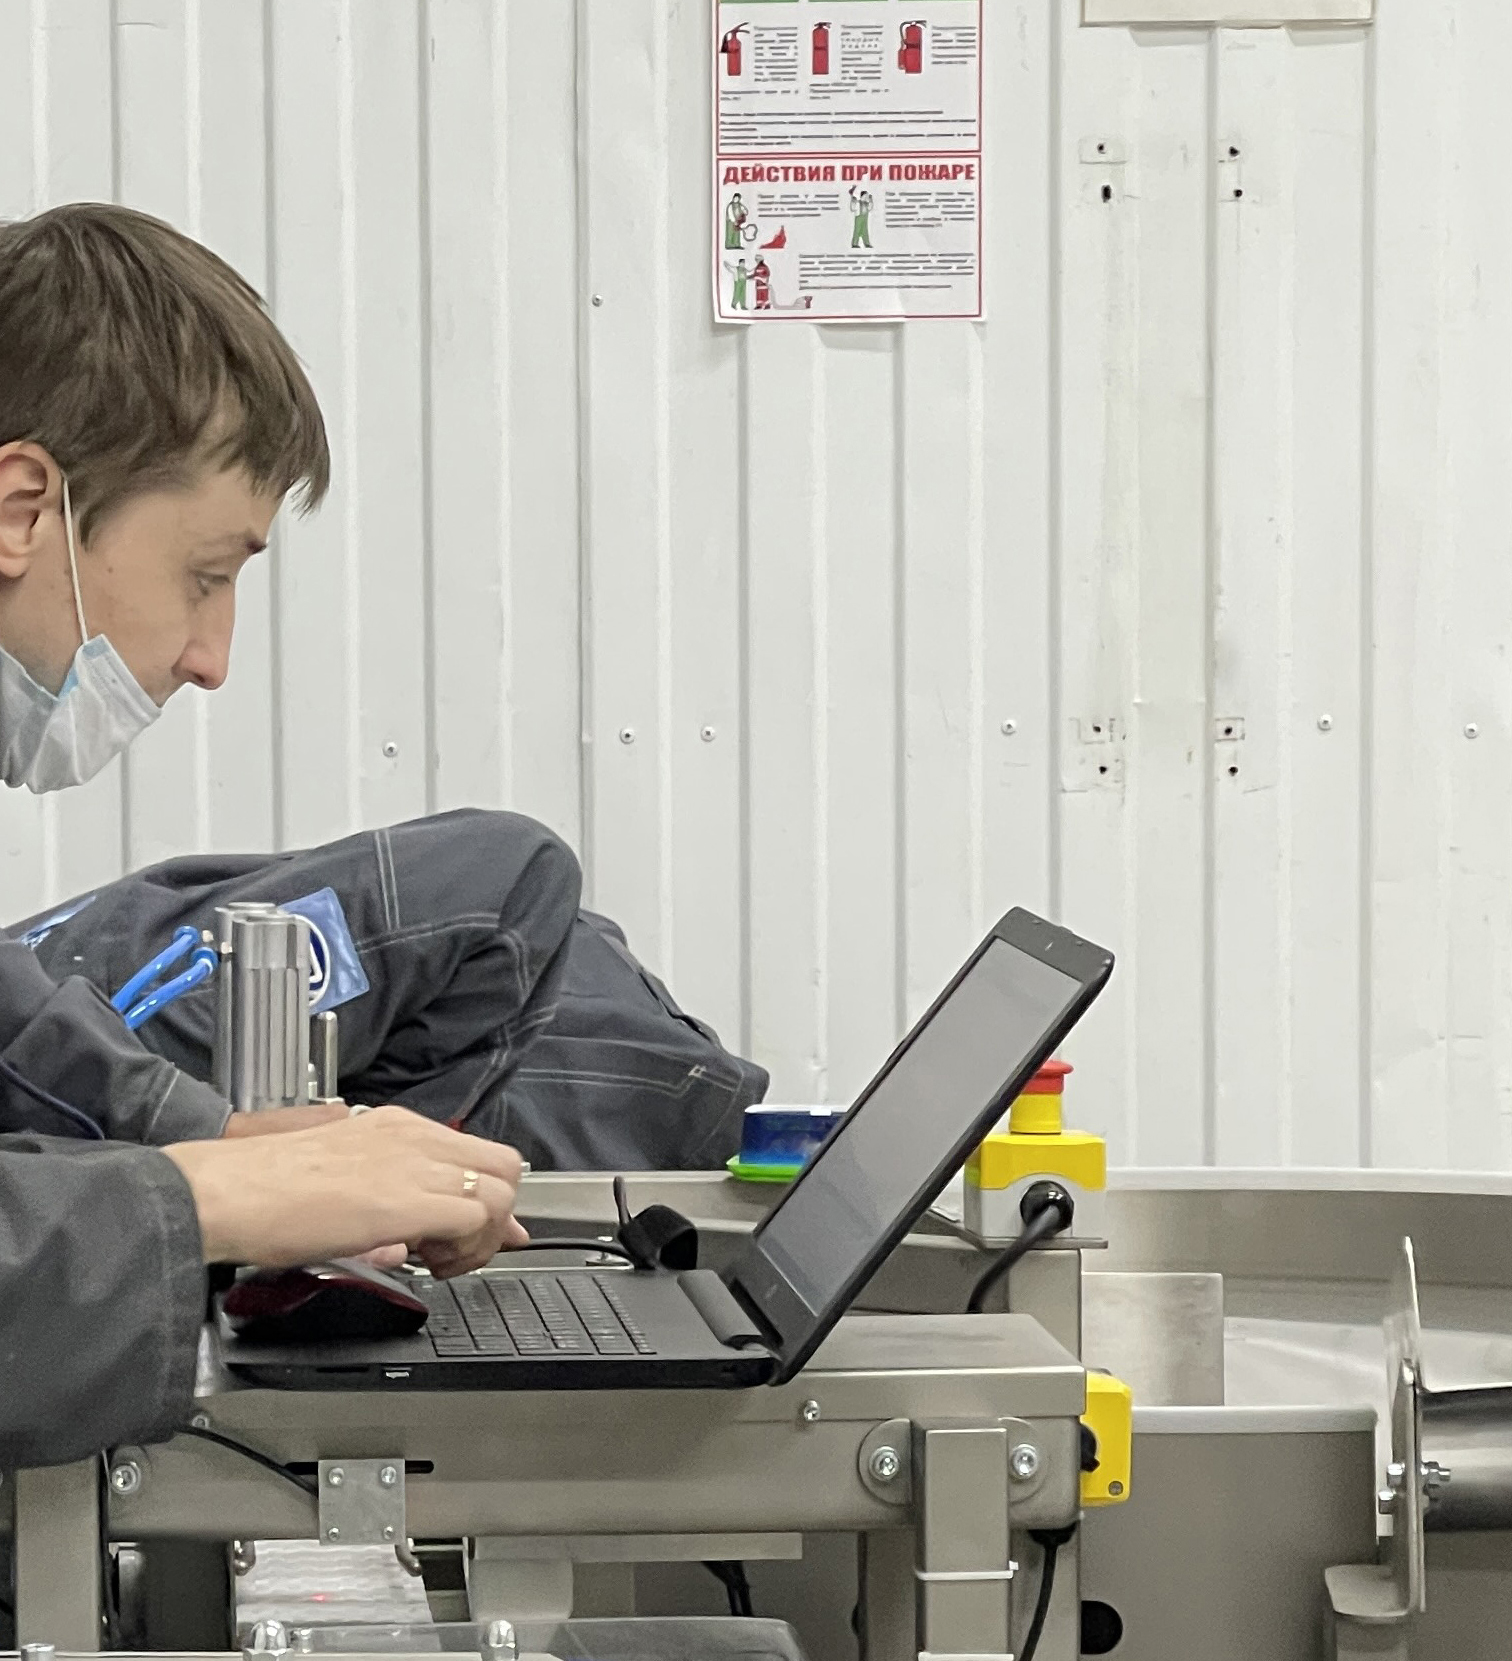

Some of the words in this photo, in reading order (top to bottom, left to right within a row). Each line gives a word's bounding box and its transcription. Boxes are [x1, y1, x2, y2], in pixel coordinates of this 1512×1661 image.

[723, 163, 836, 185] ДЕЙСТВИЯ
[841, 164, 883, 182] ПРИ
[889, 164, 976, 181] ПОЖАРЕ
